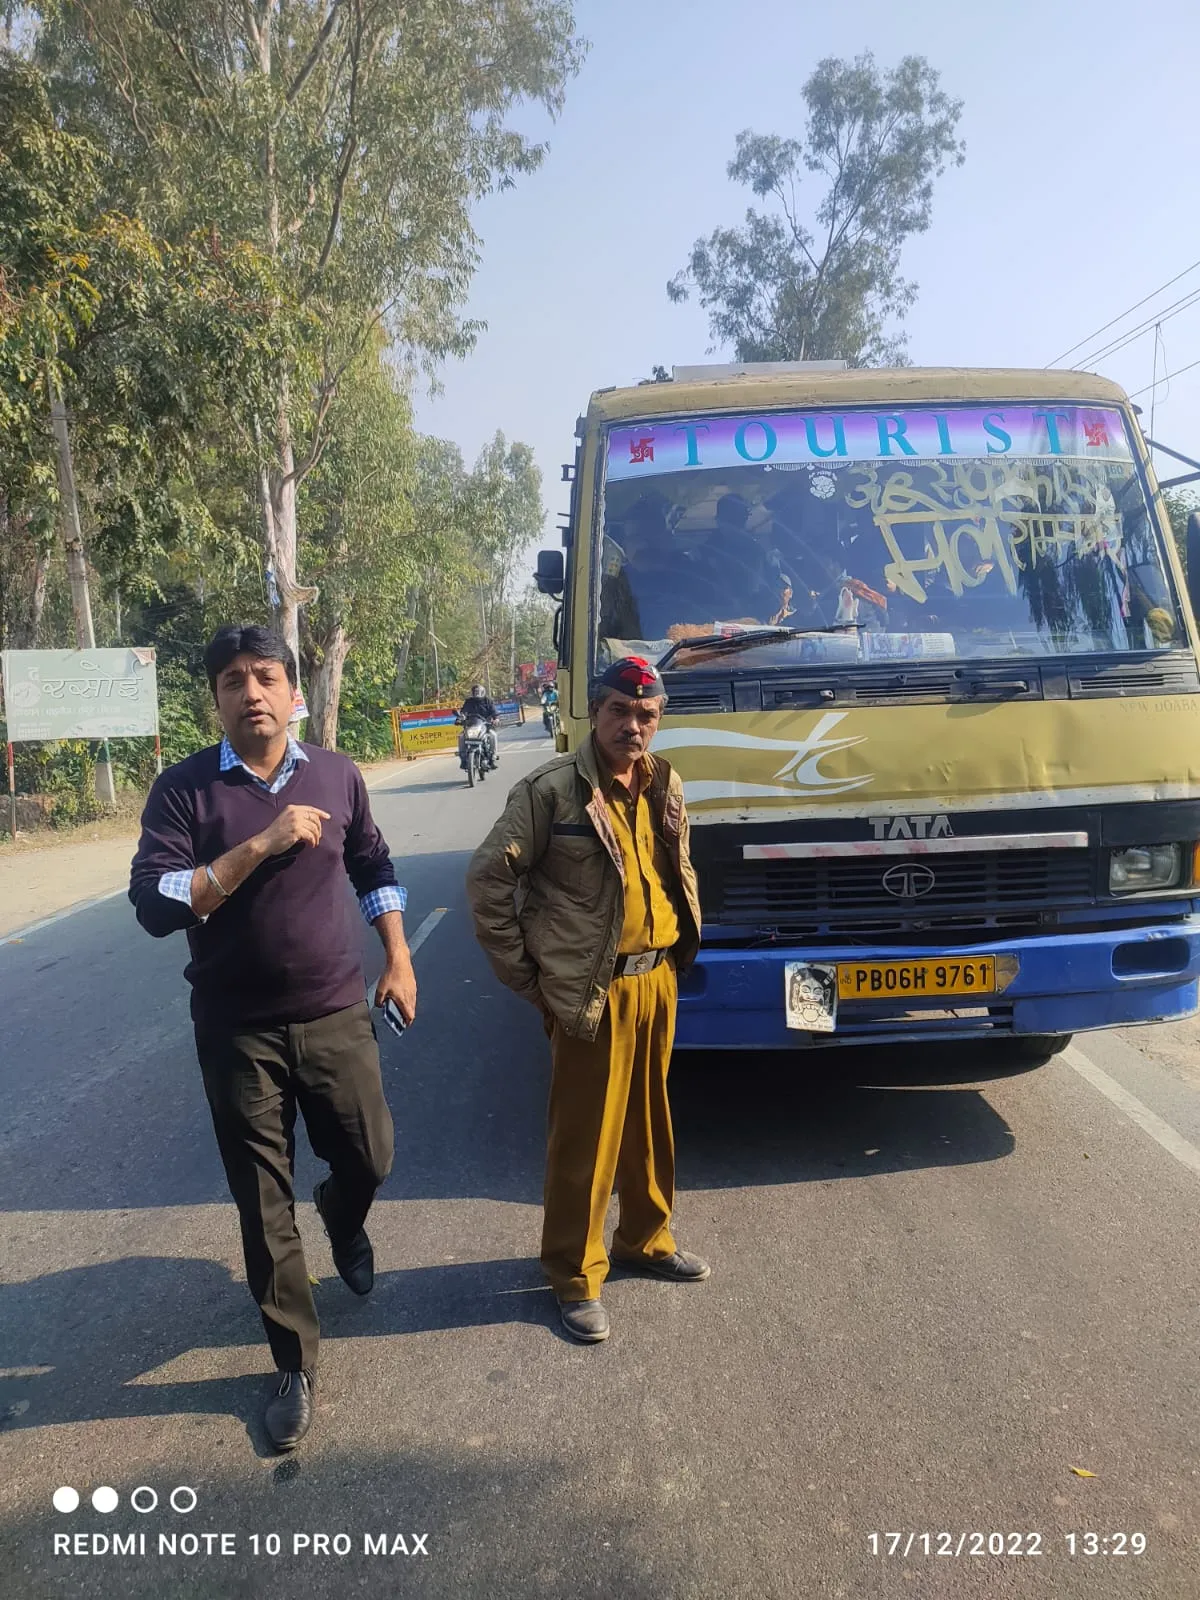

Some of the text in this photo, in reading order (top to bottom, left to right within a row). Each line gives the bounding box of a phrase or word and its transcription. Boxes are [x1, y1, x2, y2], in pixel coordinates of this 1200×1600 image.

[675, 411, 1073, 466] TOURIST
[868, 815, 955, 840] TATA
[855, 963, 988, 992] PB06H 9761
